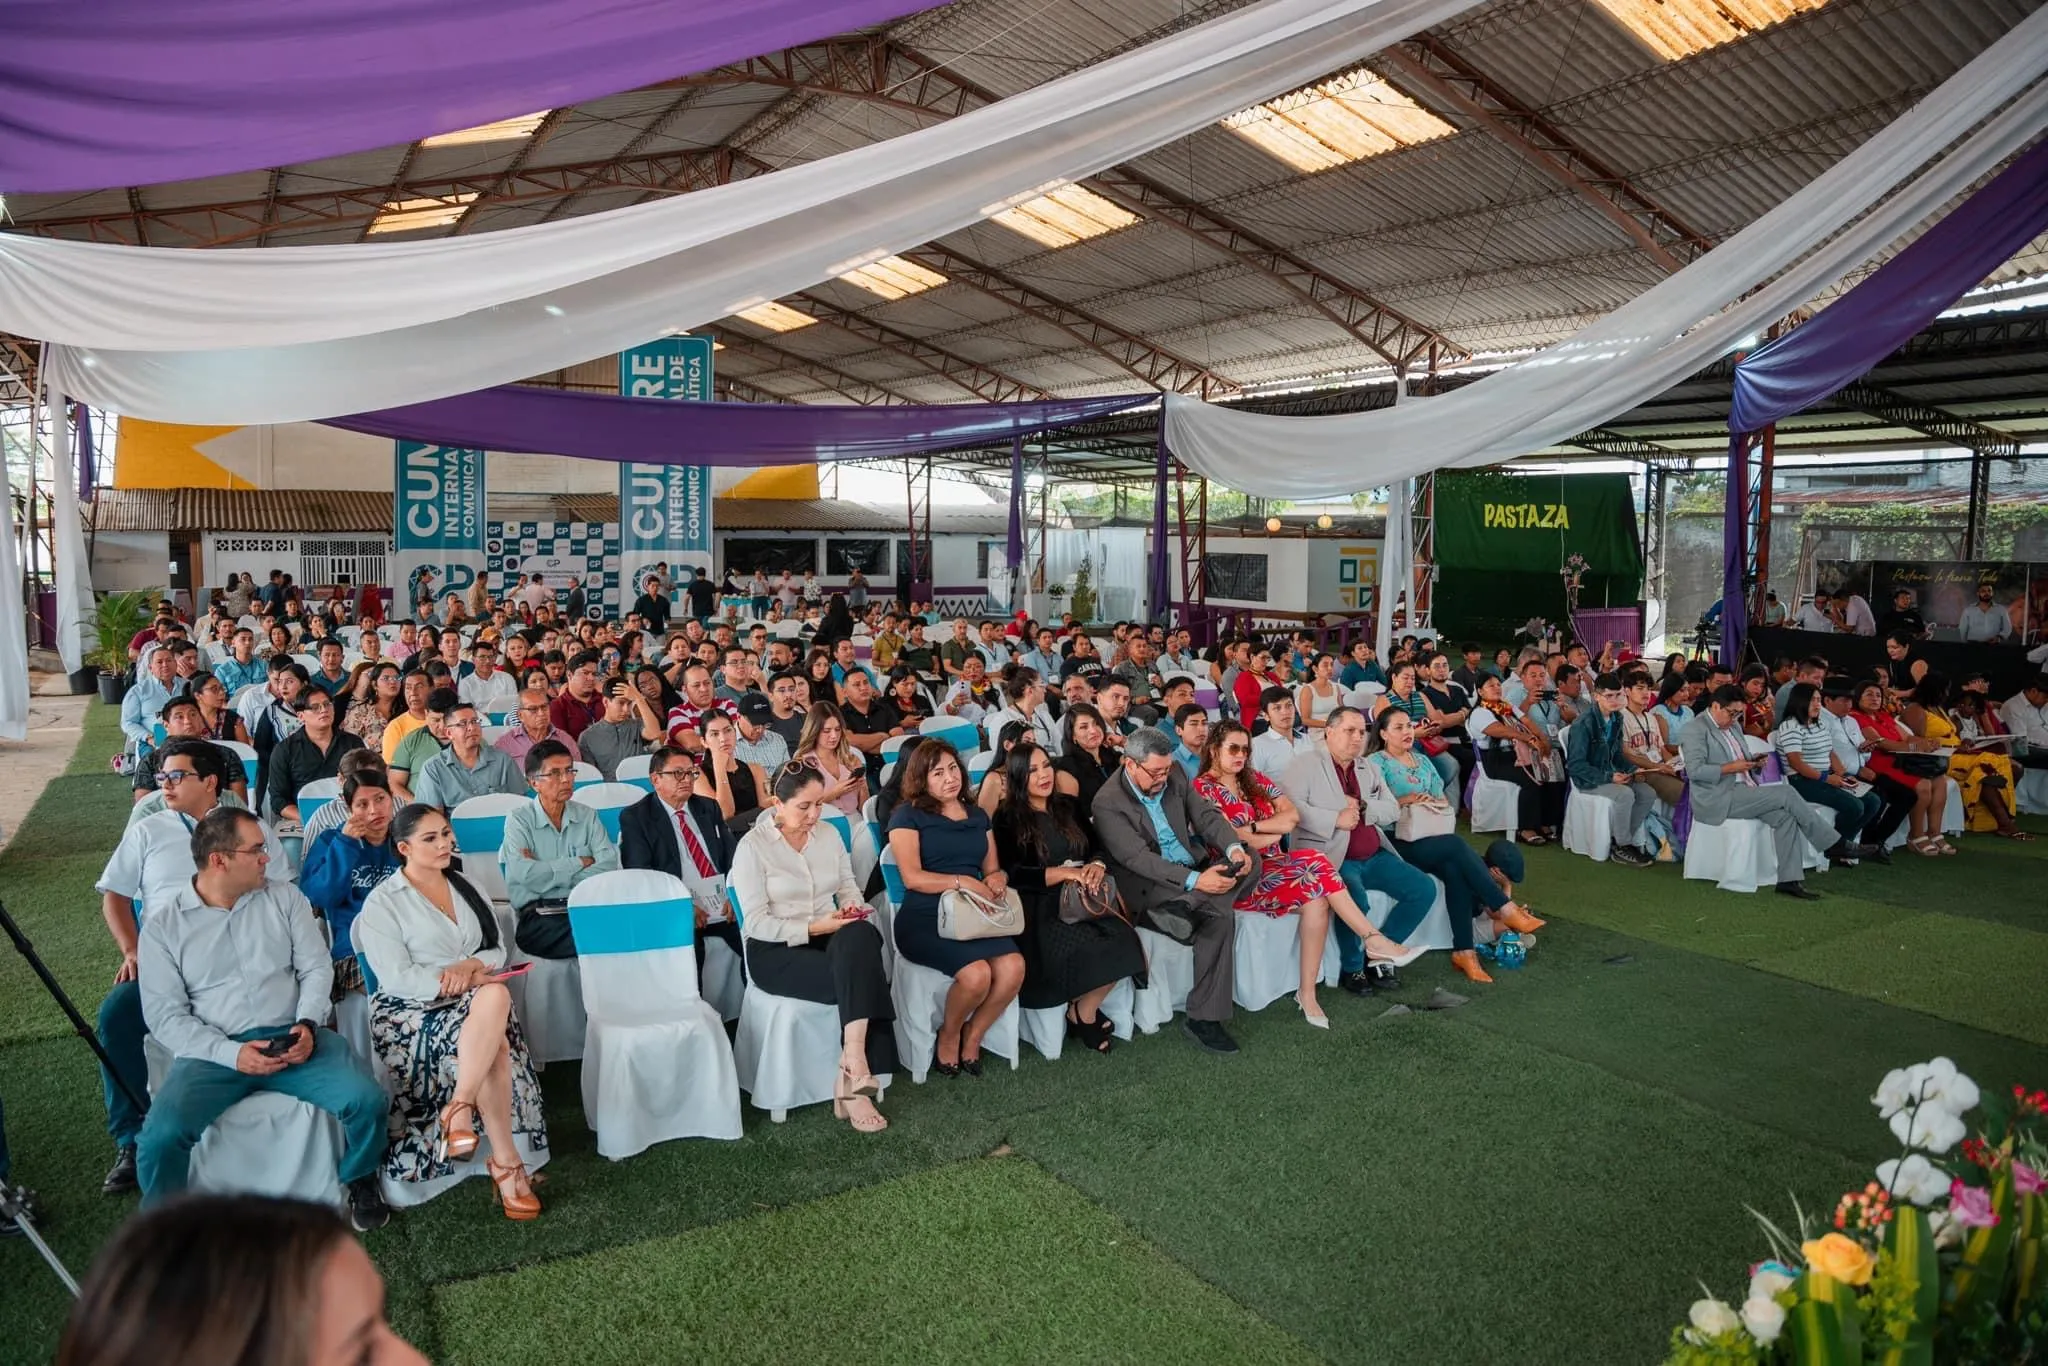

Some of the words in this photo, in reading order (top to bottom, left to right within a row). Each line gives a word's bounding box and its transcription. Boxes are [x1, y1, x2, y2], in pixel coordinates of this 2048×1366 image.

[670, 355, 685, 379] DE
[444, 447, 459, 538] INTERNA
[1484, 503, 1569, 529] PASTAZA
